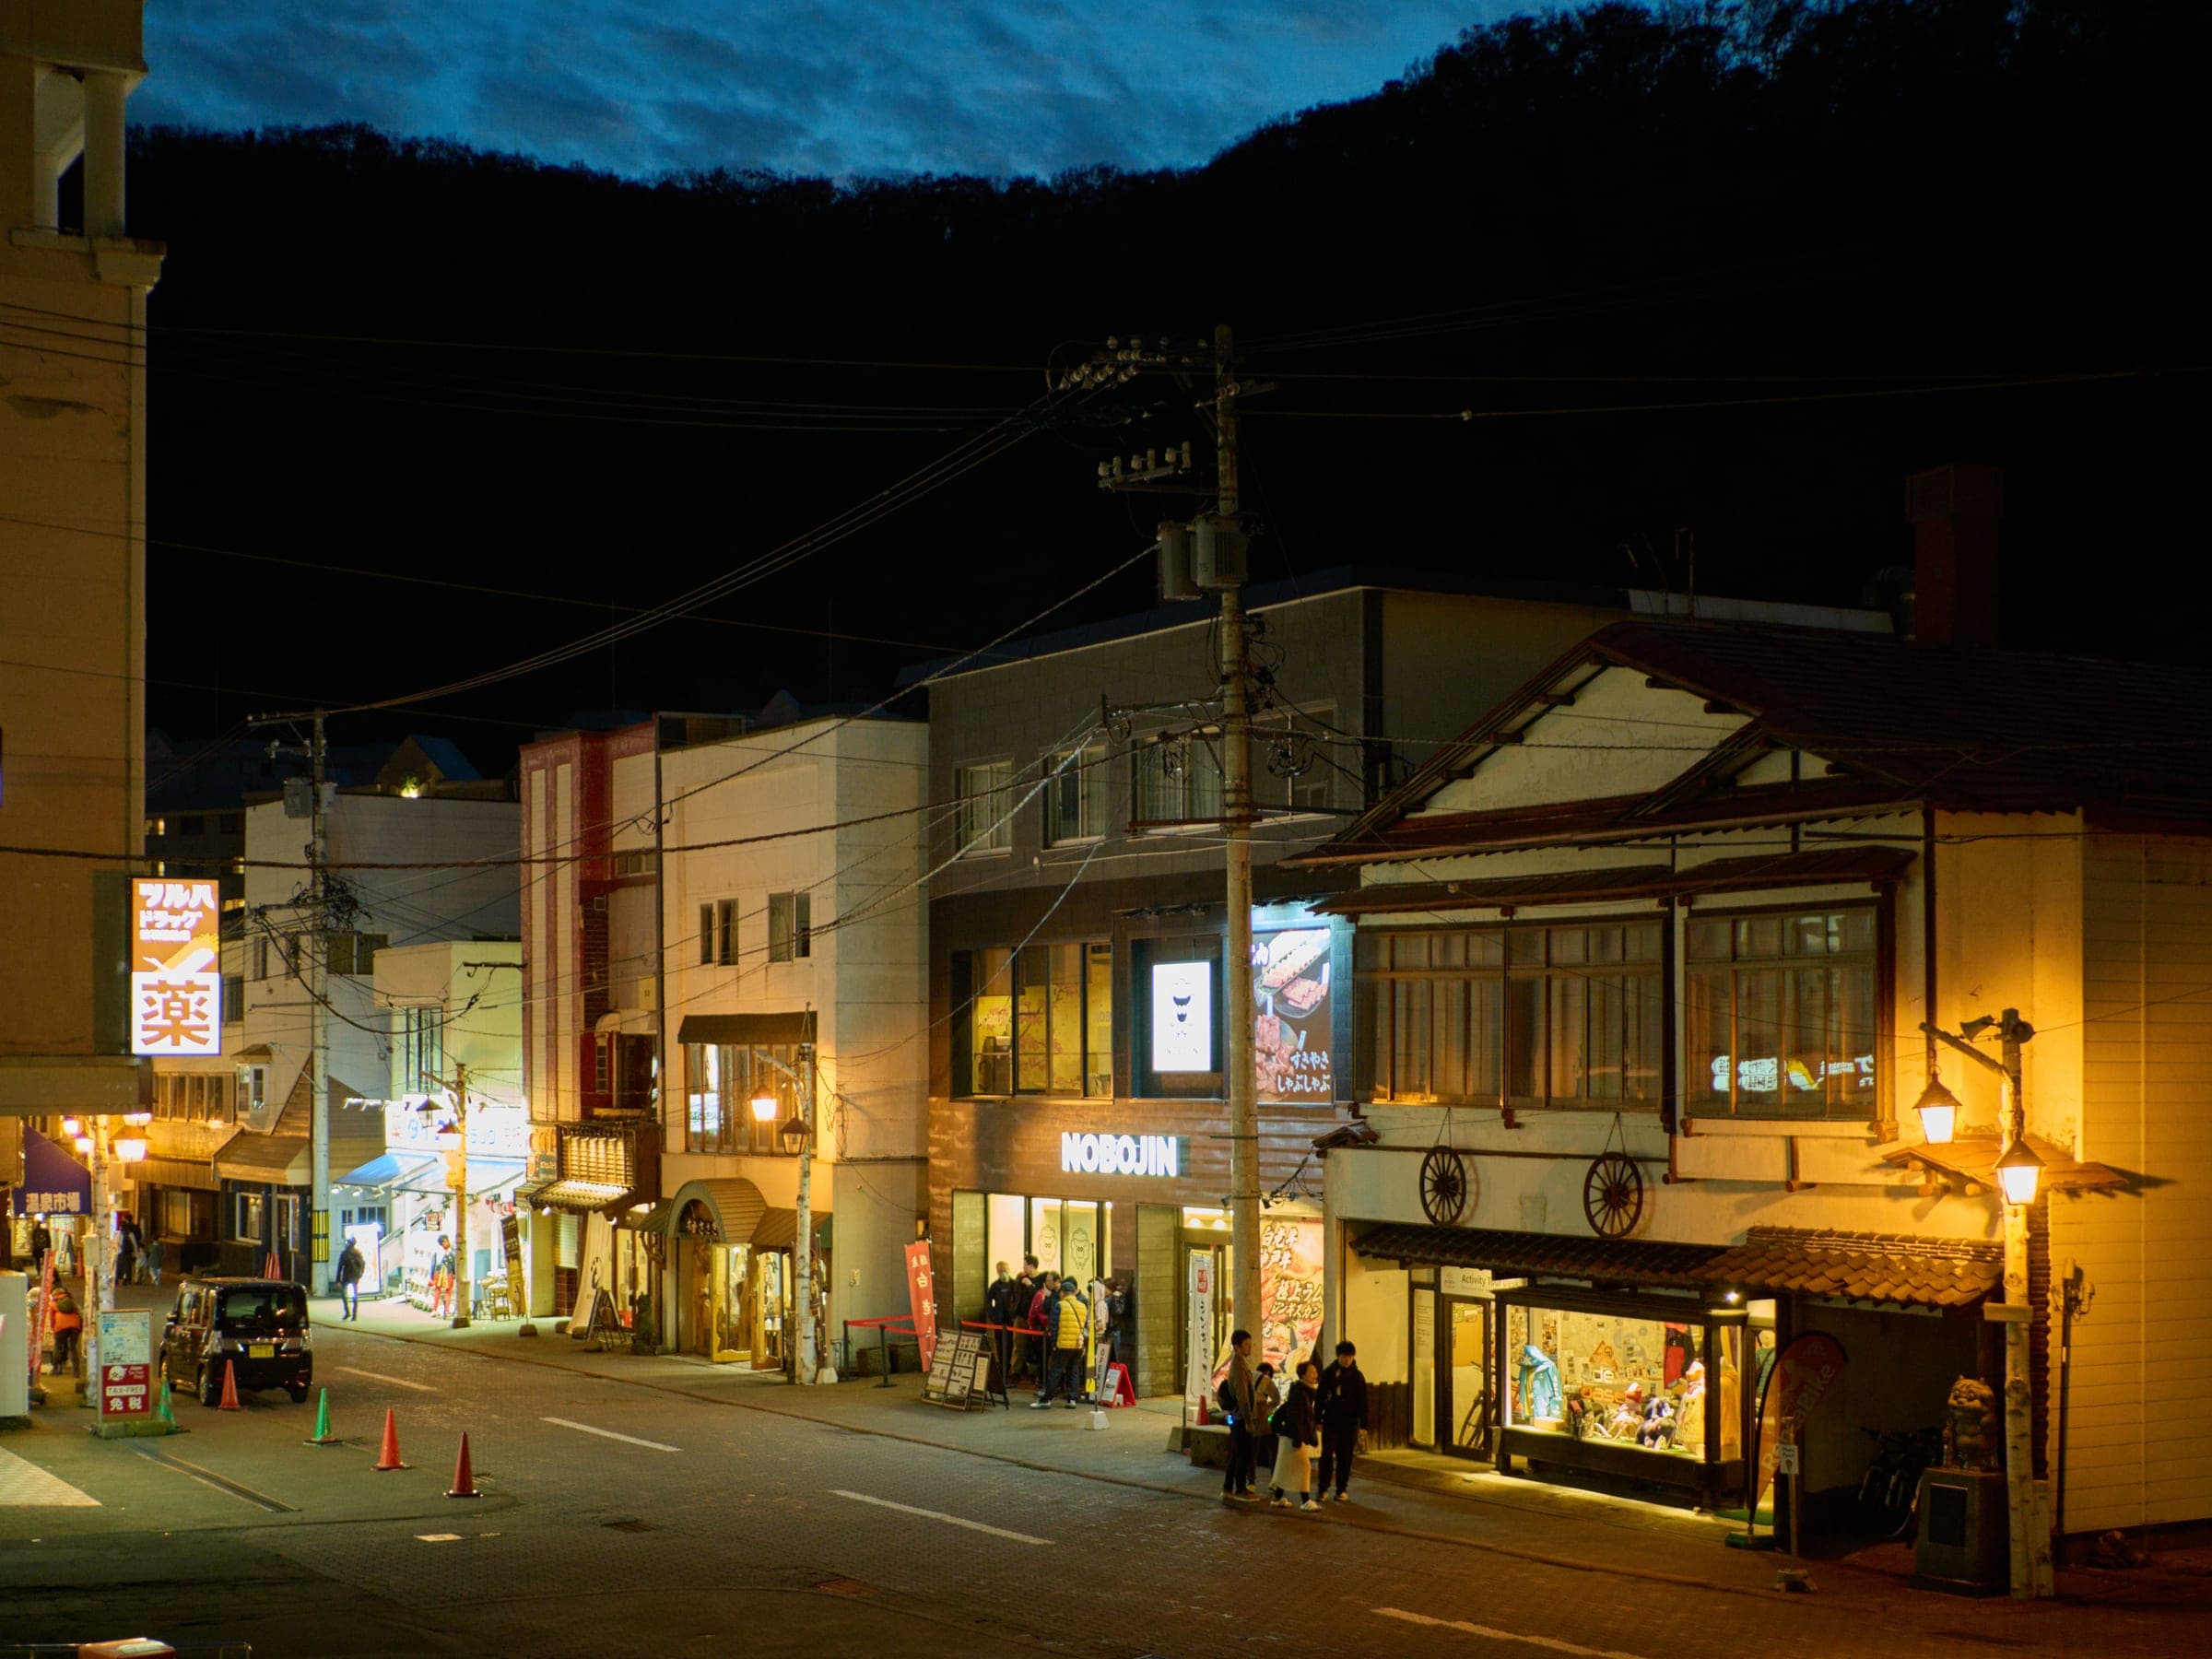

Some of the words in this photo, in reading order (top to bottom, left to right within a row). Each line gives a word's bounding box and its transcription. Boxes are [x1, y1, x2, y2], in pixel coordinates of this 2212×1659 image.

[138, 883, 216, 910] ツルハ
[141, 979, 211, 1047] 薬
[1290, 1050, 1330, 1070] すきやき
[1277, 1074, 1331, 1094] しゃぶしゃぶ
[1061, 1131, 1178, 1178] NOBOJIN
[26, 1191, 80, 1213] 温泉市場
[1461, 1274, 1486, 1288] Activity
[1270, 1300, 1321, 1319] ジンギスカン
[110, 1386, 144, 1394] TAX-FREE
[110, 1396, 142, 1411] 免税
